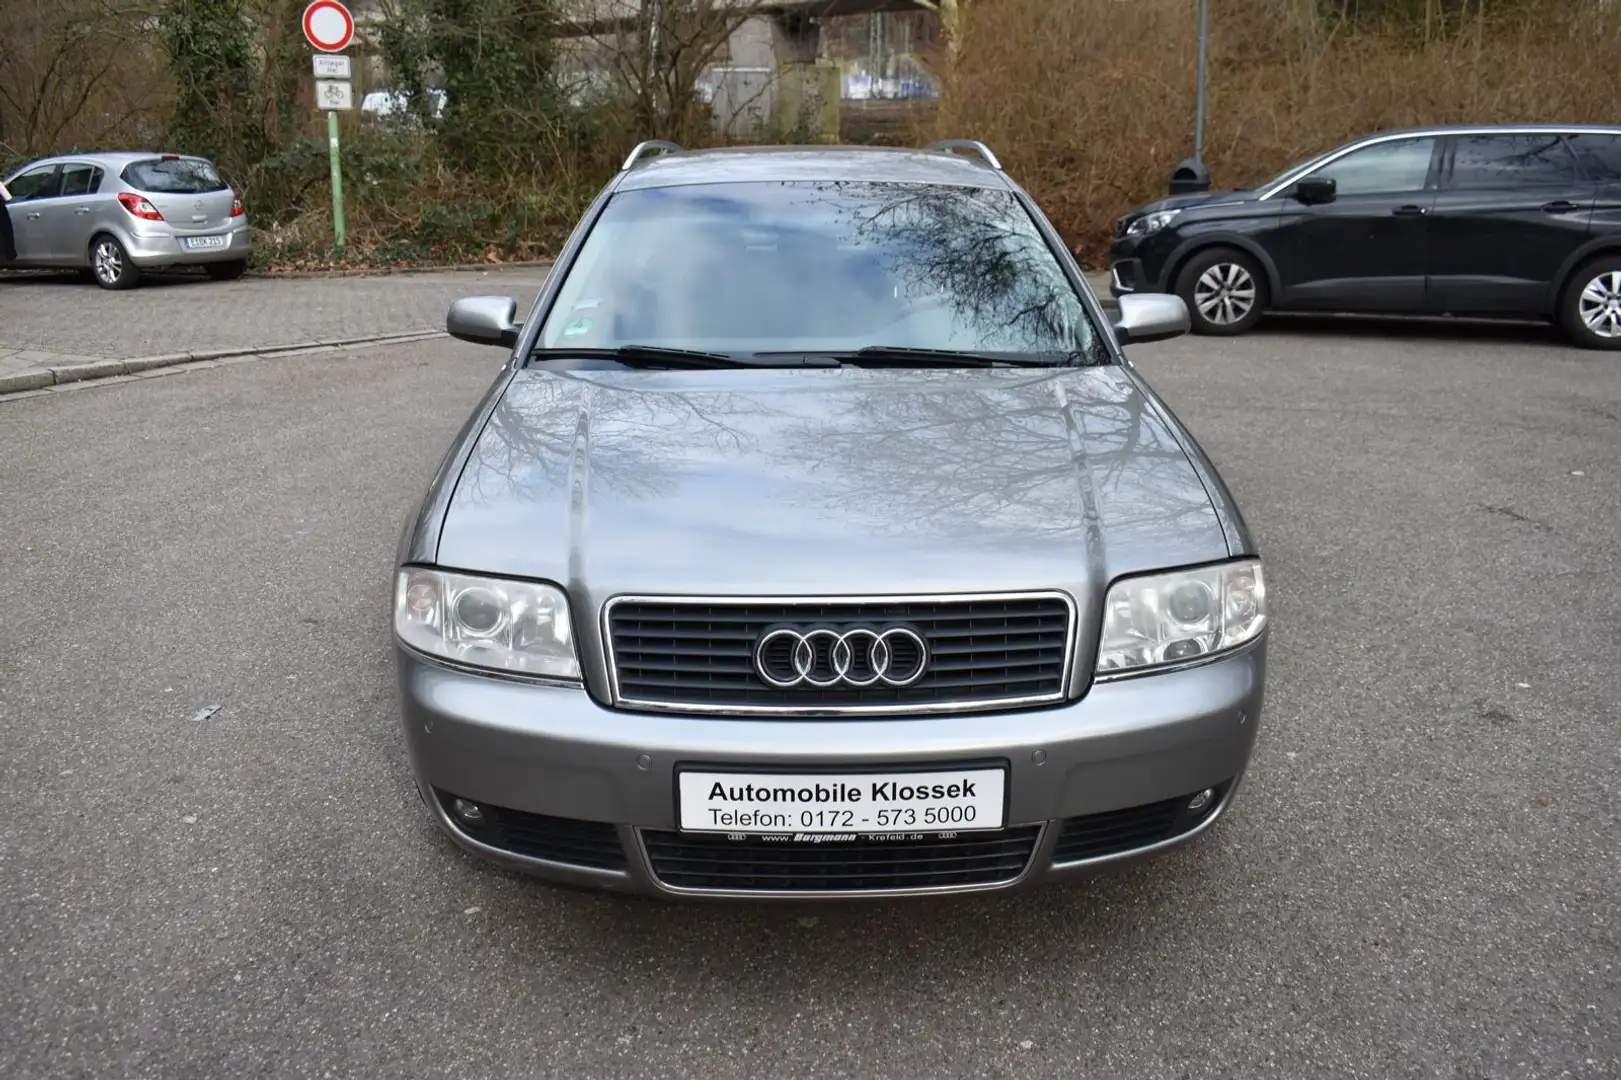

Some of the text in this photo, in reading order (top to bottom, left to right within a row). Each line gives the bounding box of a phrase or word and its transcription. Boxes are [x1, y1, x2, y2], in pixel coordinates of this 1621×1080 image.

[708, 779, 977, 803] Automobile Klossek
[708, 808, 792, 827] Telefon:
[800, 810, 854, 827] 0172
[877, 808, 916, 826] 573
[924, 805, 976, 824] 5000
